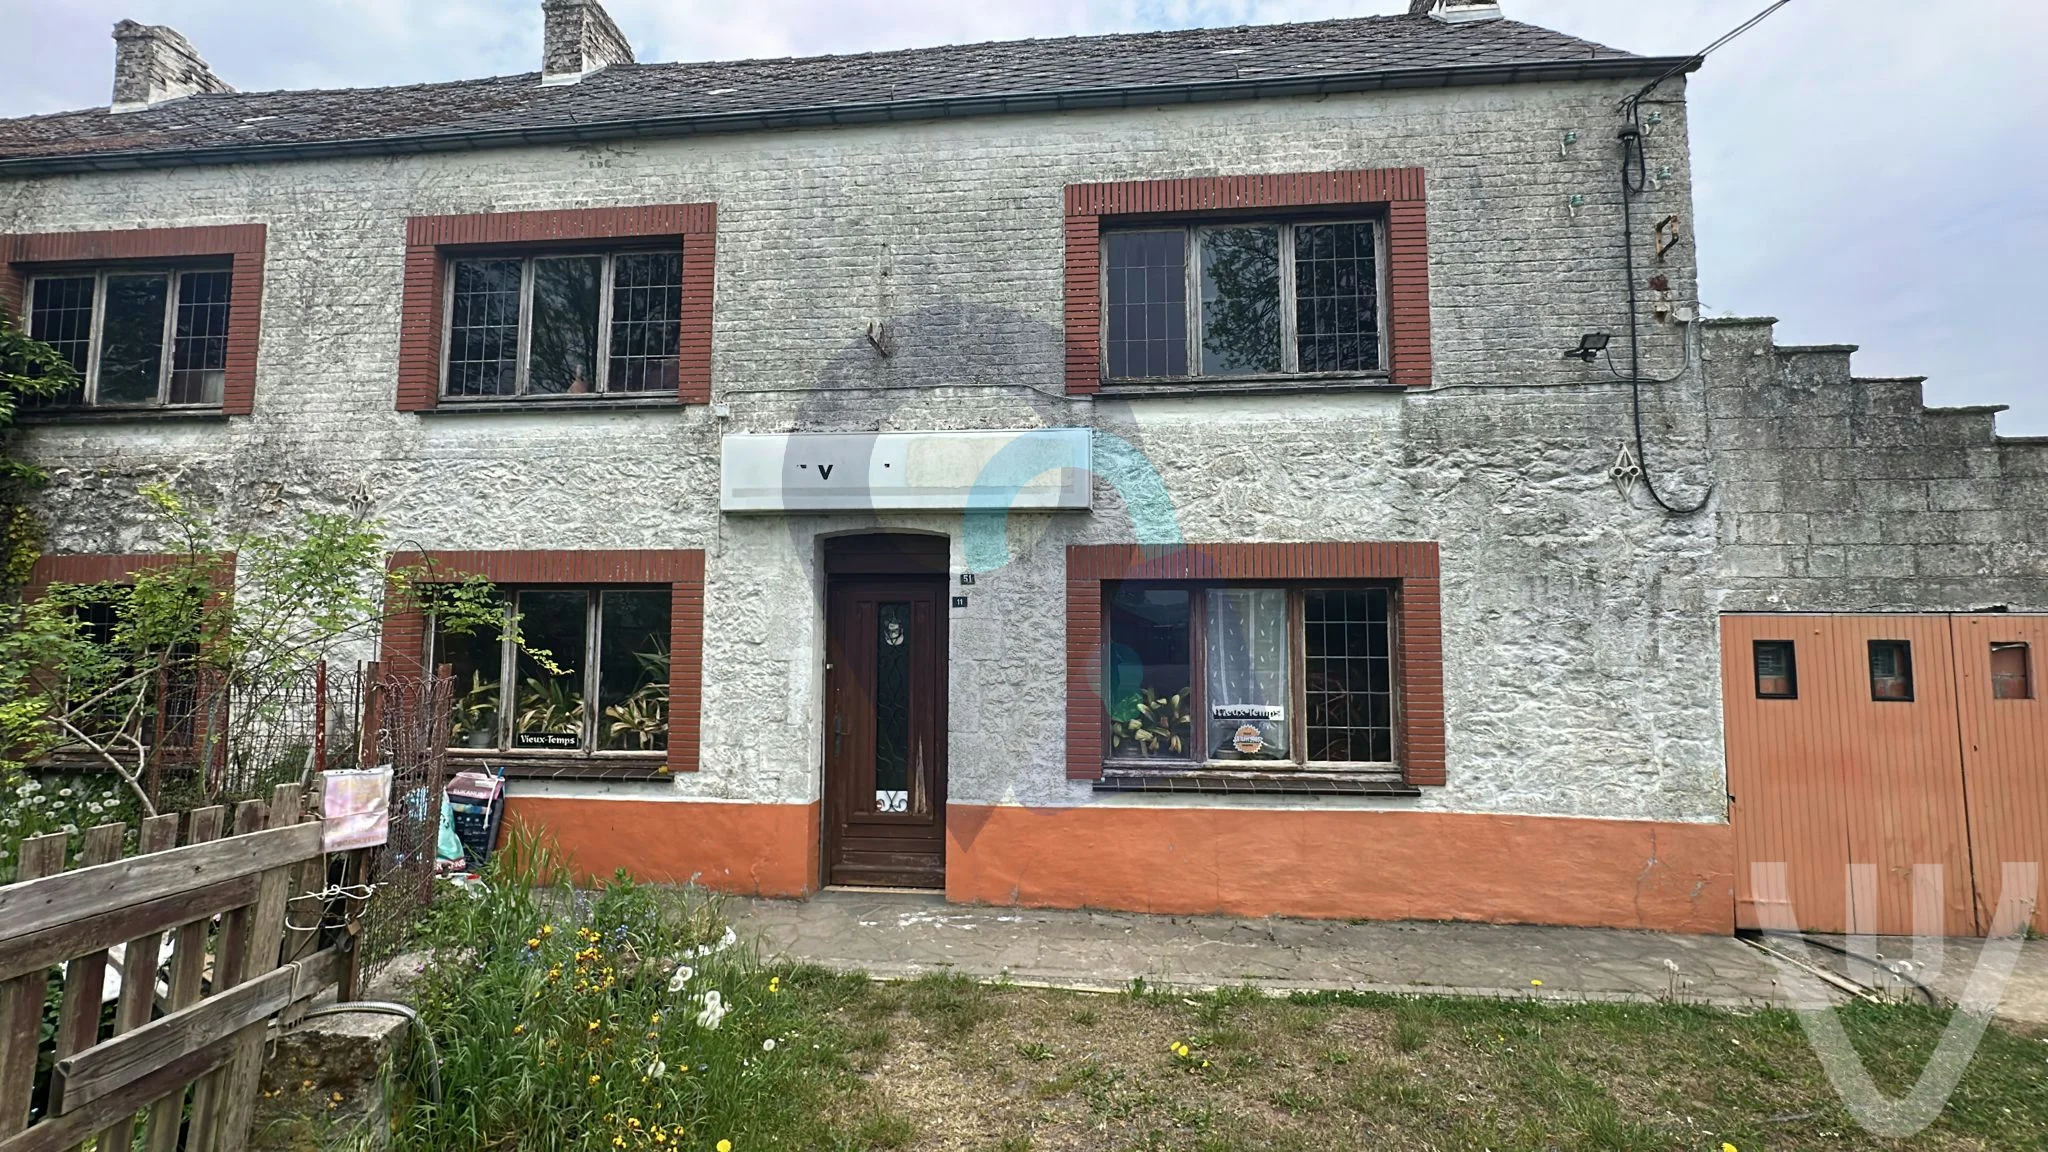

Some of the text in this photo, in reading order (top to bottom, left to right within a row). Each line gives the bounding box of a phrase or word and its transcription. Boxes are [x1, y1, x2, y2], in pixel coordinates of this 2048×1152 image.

[963, 574, 972, 583] 51
[957, 598, 963, 606] 11
[520, 734, 576, 746] Vieux-Temps
